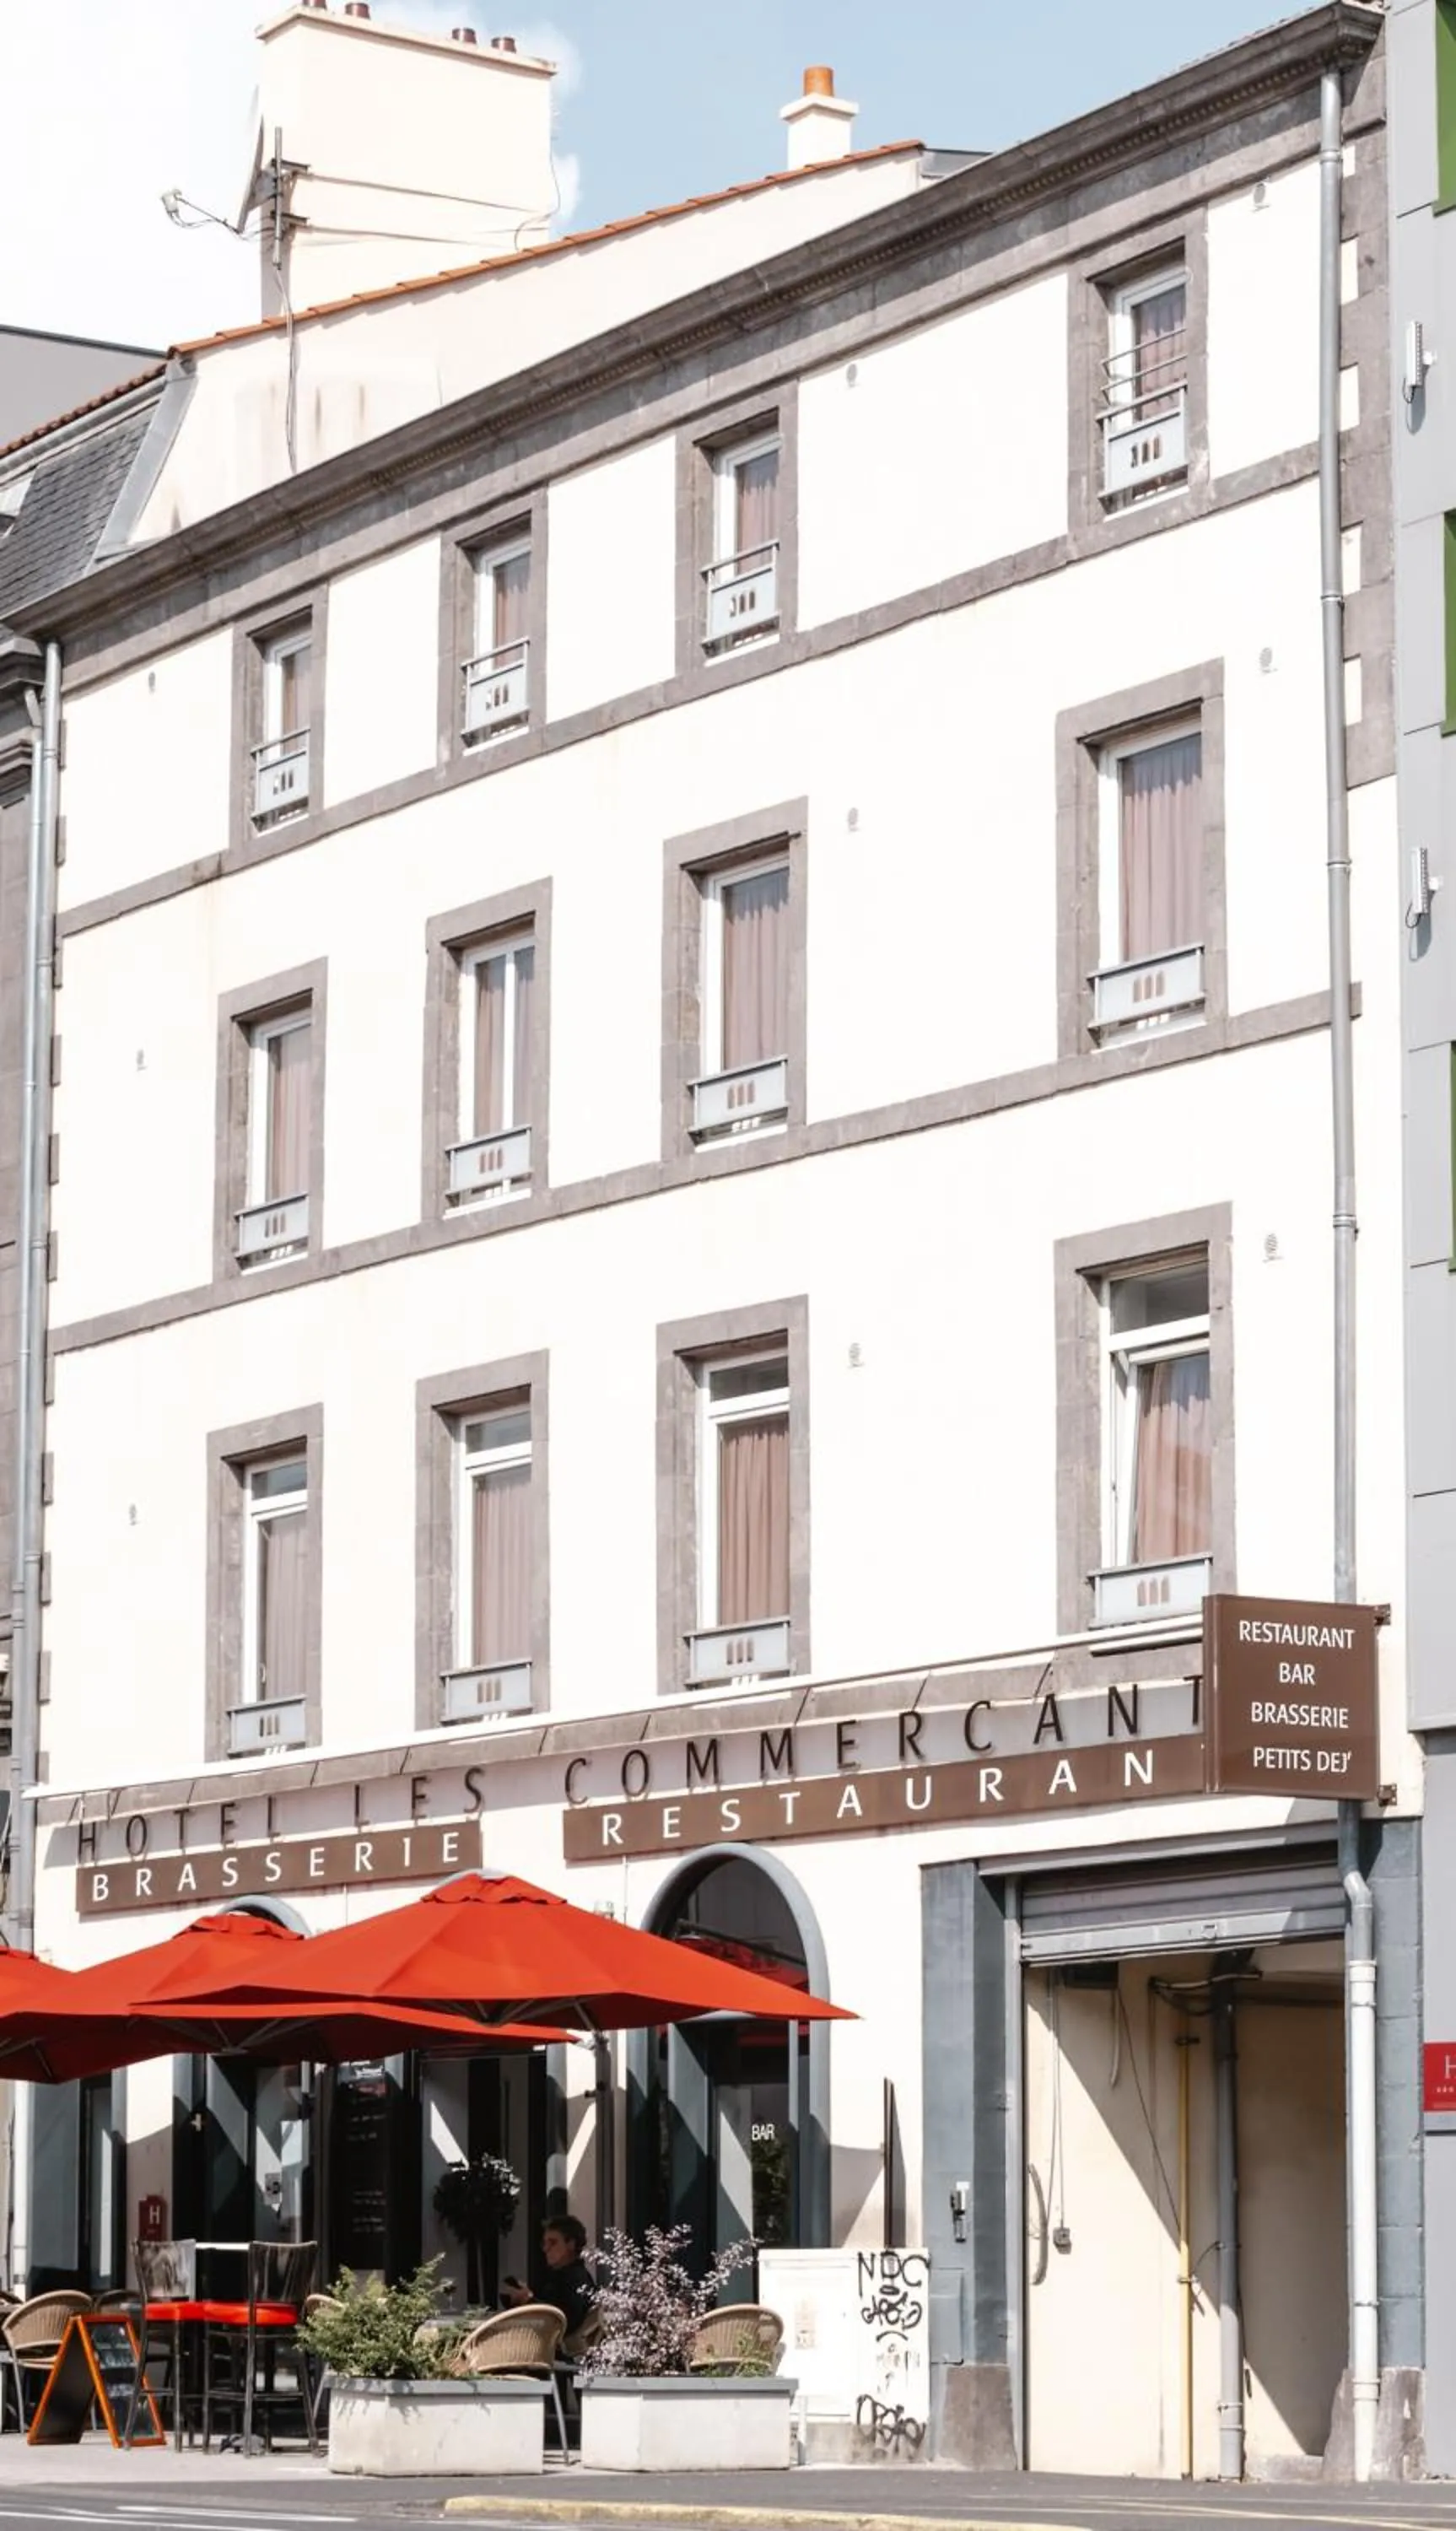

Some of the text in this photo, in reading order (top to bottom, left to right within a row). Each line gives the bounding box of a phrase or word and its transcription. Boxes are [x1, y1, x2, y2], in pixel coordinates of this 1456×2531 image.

[1239, 1620, 1355, 1649] RESTAURANT
[1279, 1662, 1316, 1686] BAR
[1251, 1702, 1349, 1729] BRASSERIE
[1253, 1747, 1312, 1771] PETITS
[78, 1795, 281, 1865] HOTEL
[353, 1767, 485, 1828] LES
[93, 1832, 460, 1902] BRASSERIE
[752, 2123, 776, 2141] BAR
[149, 2205, 160, 2225] H
